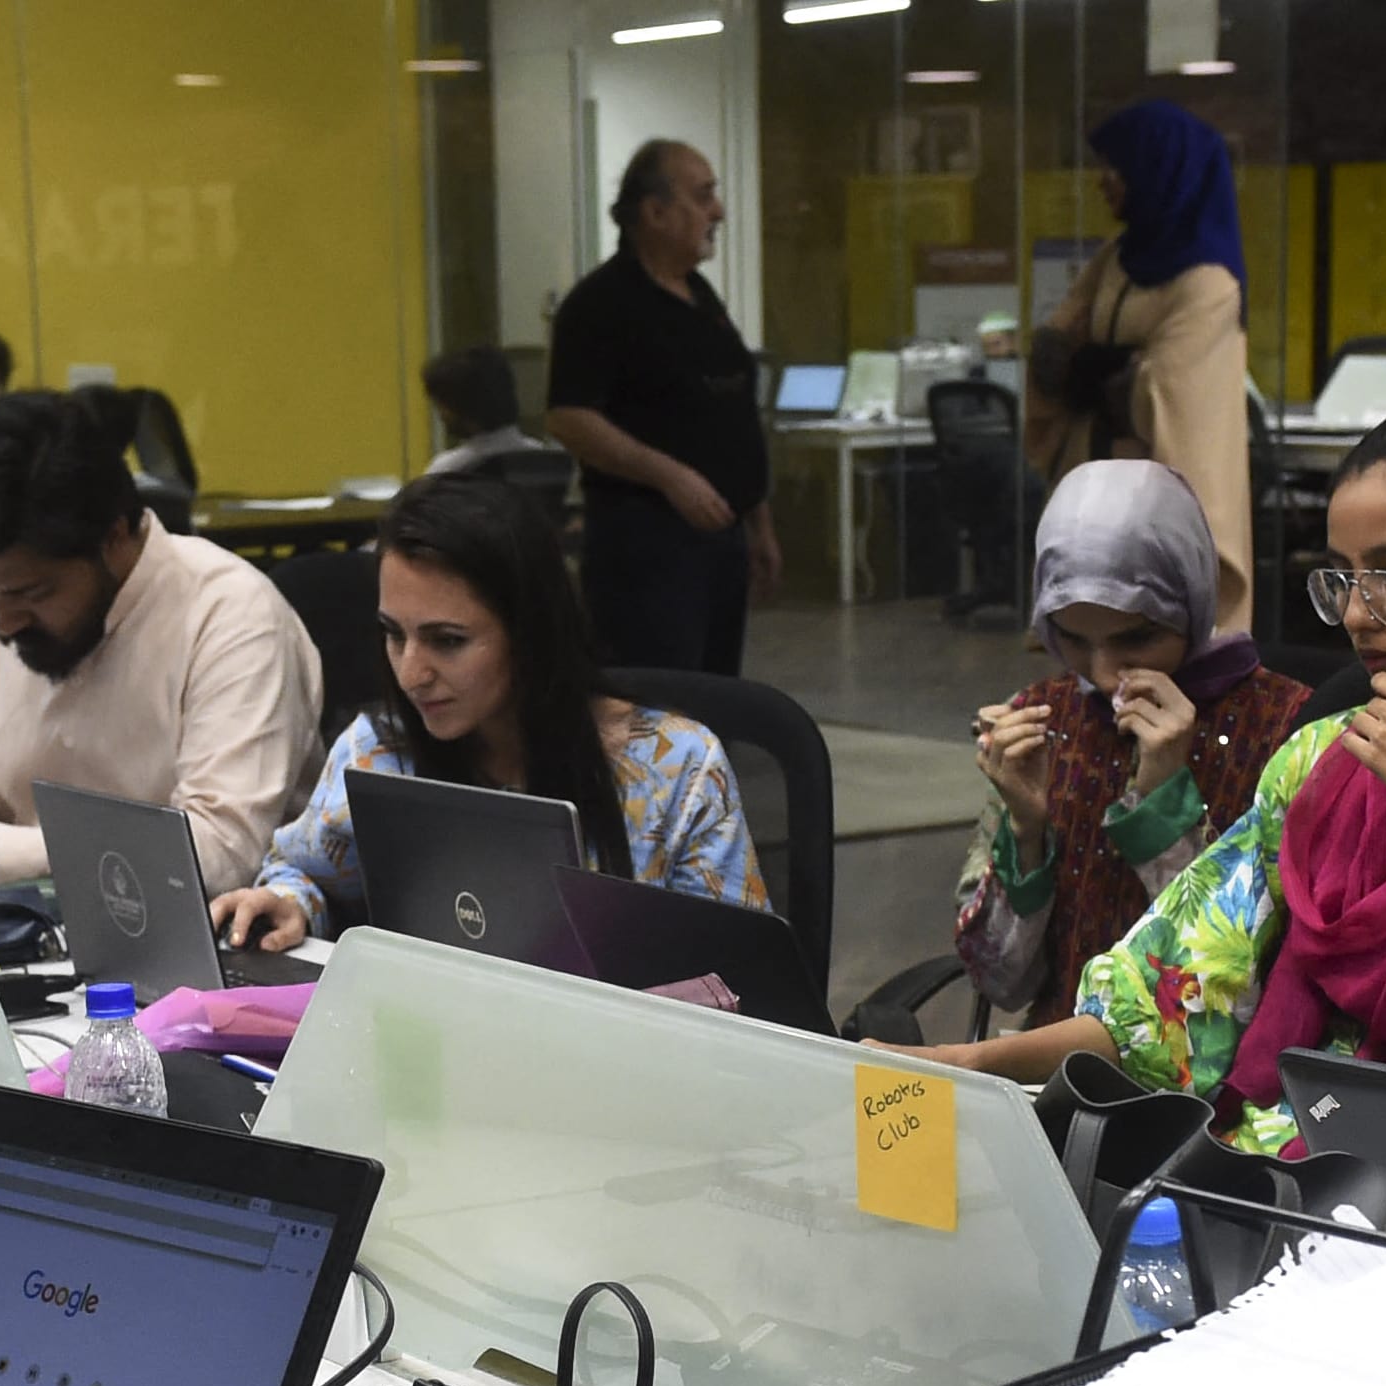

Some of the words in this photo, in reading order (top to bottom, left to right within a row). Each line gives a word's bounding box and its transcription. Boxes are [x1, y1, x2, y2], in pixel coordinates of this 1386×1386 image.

[863, 1080, 926, 1119] Robotics
[877, 1113, 921, 1151] Club
[23, 1269, 99, 1318] Google
